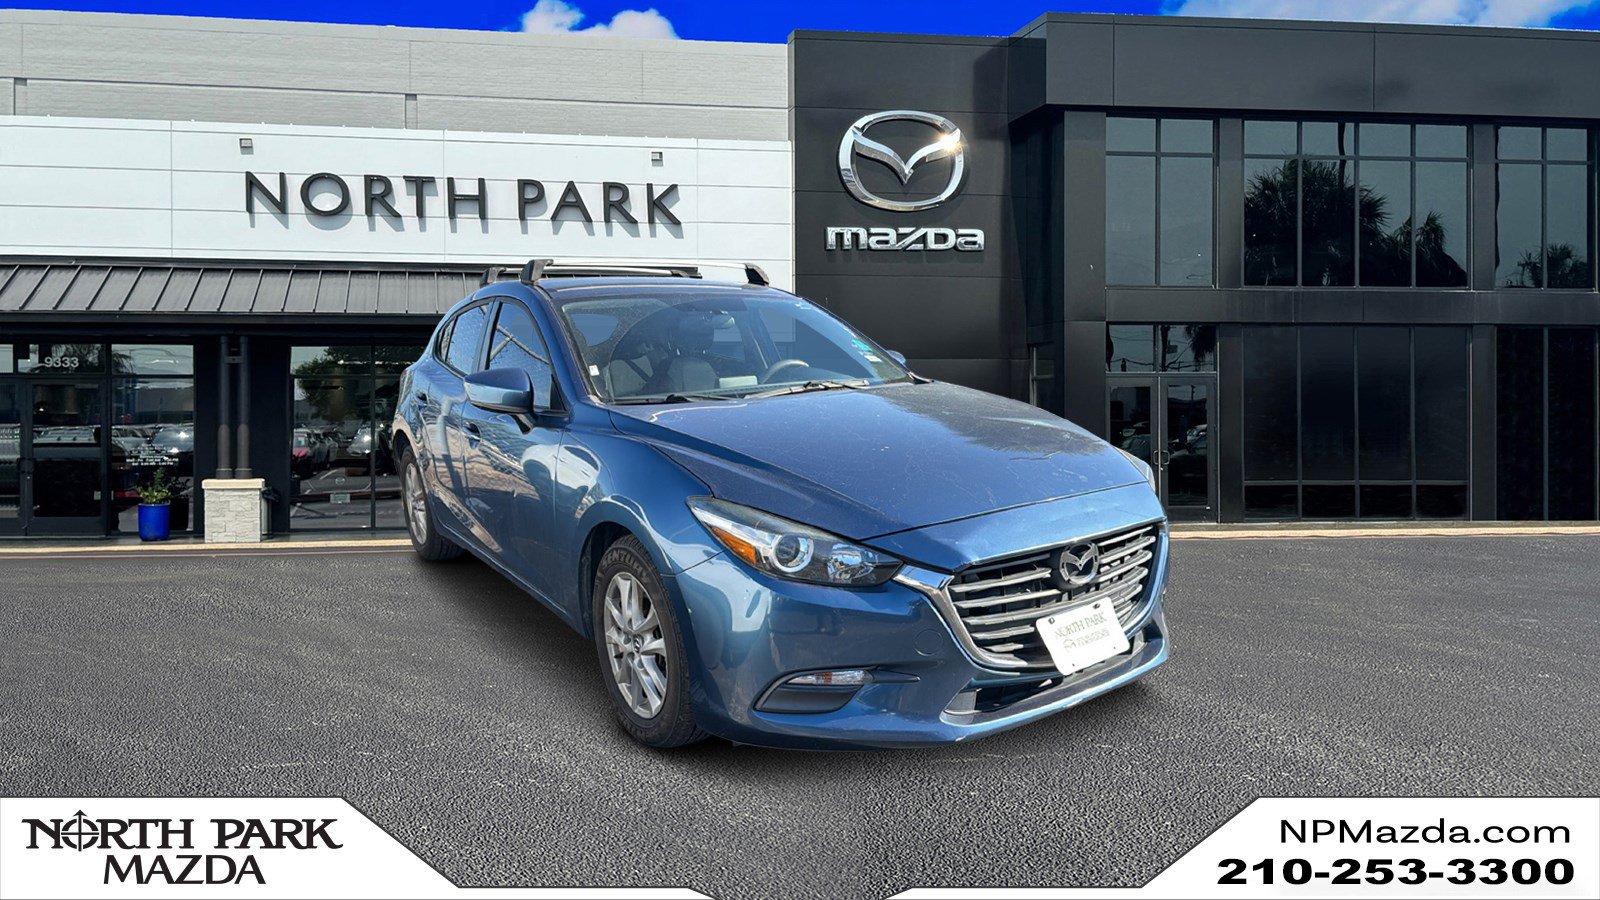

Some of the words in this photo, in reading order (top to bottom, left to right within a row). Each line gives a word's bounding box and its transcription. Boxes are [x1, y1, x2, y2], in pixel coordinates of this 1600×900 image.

[245, 171, 487, 220] NORTH
[517, 178, 681, 225] PARK
[44, 356, 79, 368] 9333
[1054, 620, 1086, 638] NORTH
[1084, 611, 1108, 628] PARK
